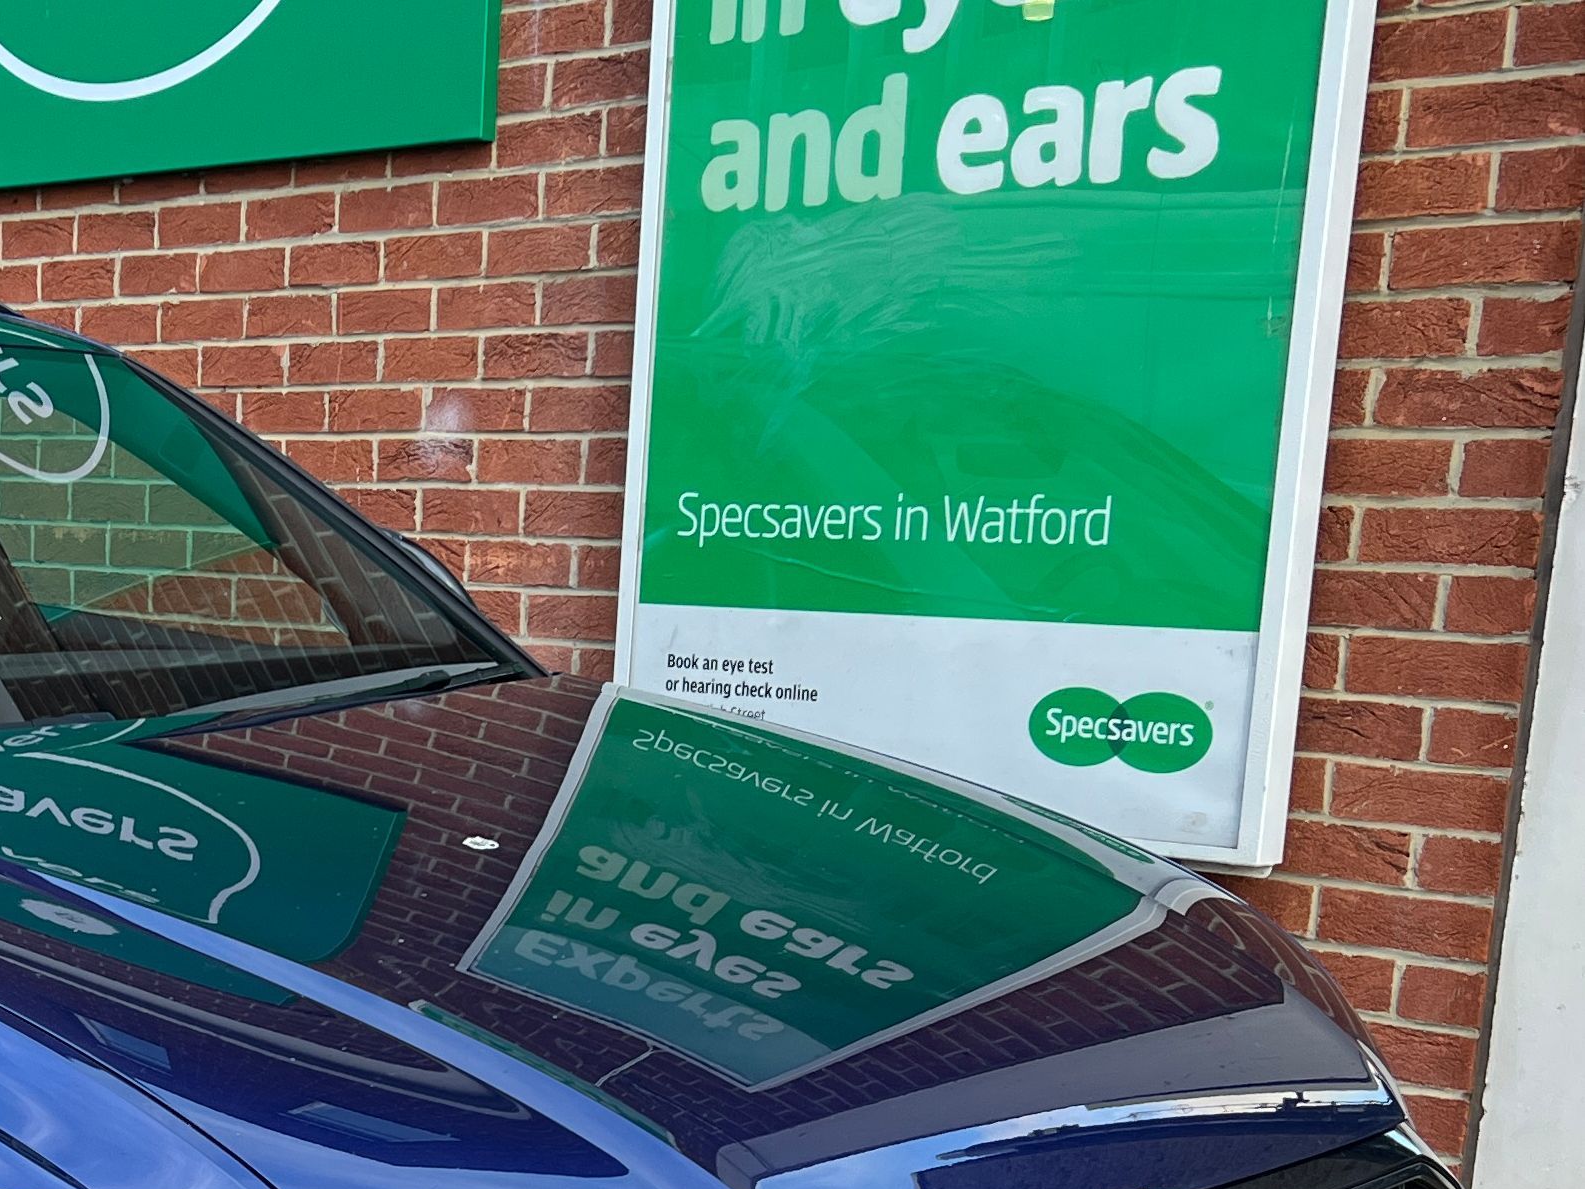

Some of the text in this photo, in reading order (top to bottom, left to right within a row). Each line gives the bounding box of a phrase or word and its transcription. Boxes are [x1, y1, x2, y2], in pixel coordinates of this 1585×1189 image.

[700, 65, 1222, 213] and ears
[677, 491, 1113, 548] Specsavers in Watford
[667, 653, 774, 675] Book an eye test
[665, 677, 818, 701] or hearing check online
[1045, 707, 1195, 746] Specsavers
